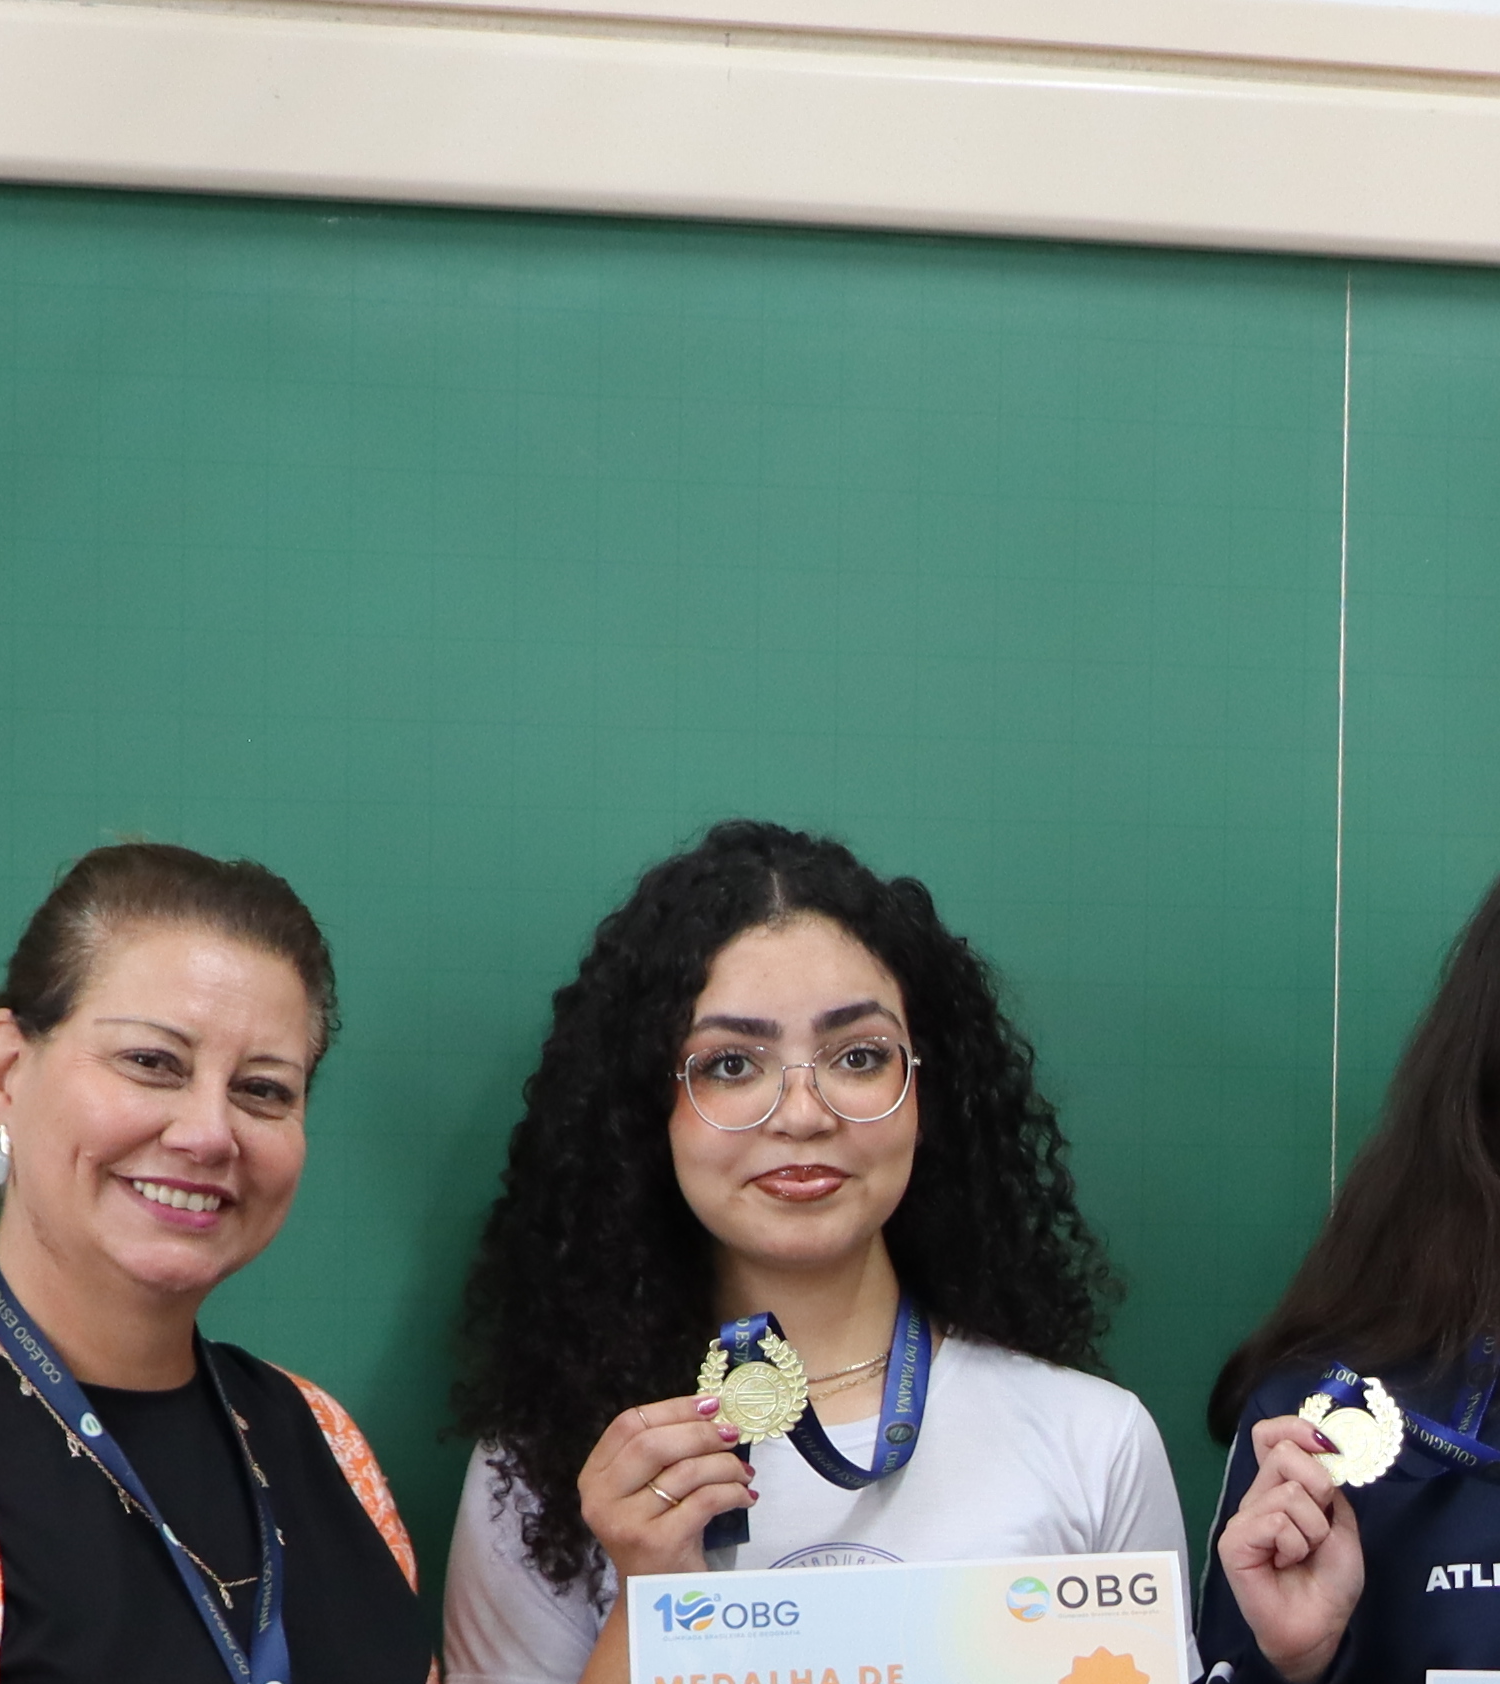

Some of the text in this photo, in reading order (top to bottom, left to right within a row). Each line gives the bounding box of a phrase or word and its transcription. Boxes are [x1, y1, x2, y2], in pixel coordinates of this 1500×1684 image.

[12, 1326, 62, 1384] COLÉGIO
[904, 1343, 919, 1363] DO
[895, 1363, 915, 1414] PARANÁ
[1335, 1368, 1360, 1387] DO
[1055, 1572, 1158, 1609] OBG
[721, 1599, 800, 1629] OBG
